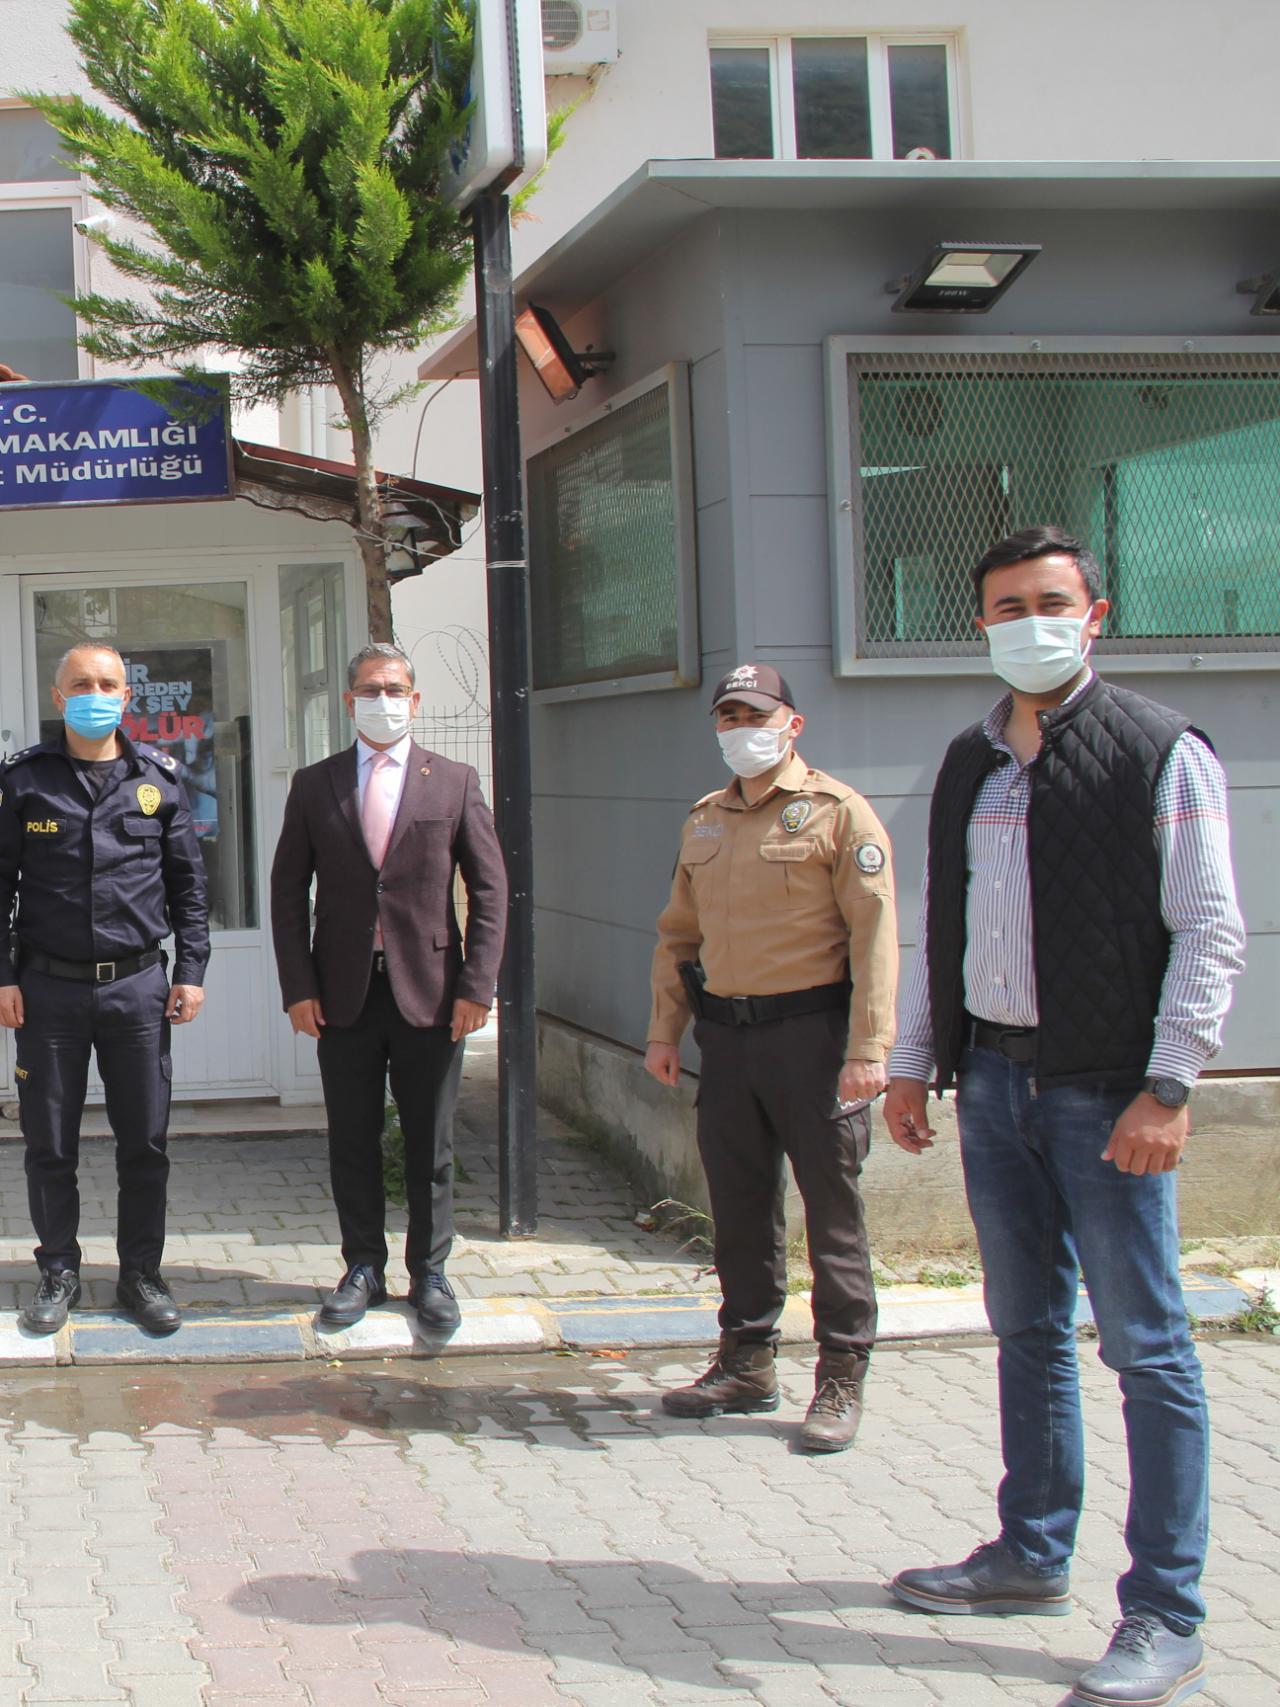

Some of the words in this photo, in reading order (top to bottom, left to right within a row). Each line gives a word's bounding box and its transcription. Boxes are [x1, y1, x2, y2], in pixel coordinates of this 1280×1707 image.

[16, 454, 202, 483] Müdürlüğü
[124, 657, 149, 683] İR
[132, 681, 192, 697] REDEN
[146, 695, 192, 714] ŞEY
[27, 819, 58, 832] POLİS
